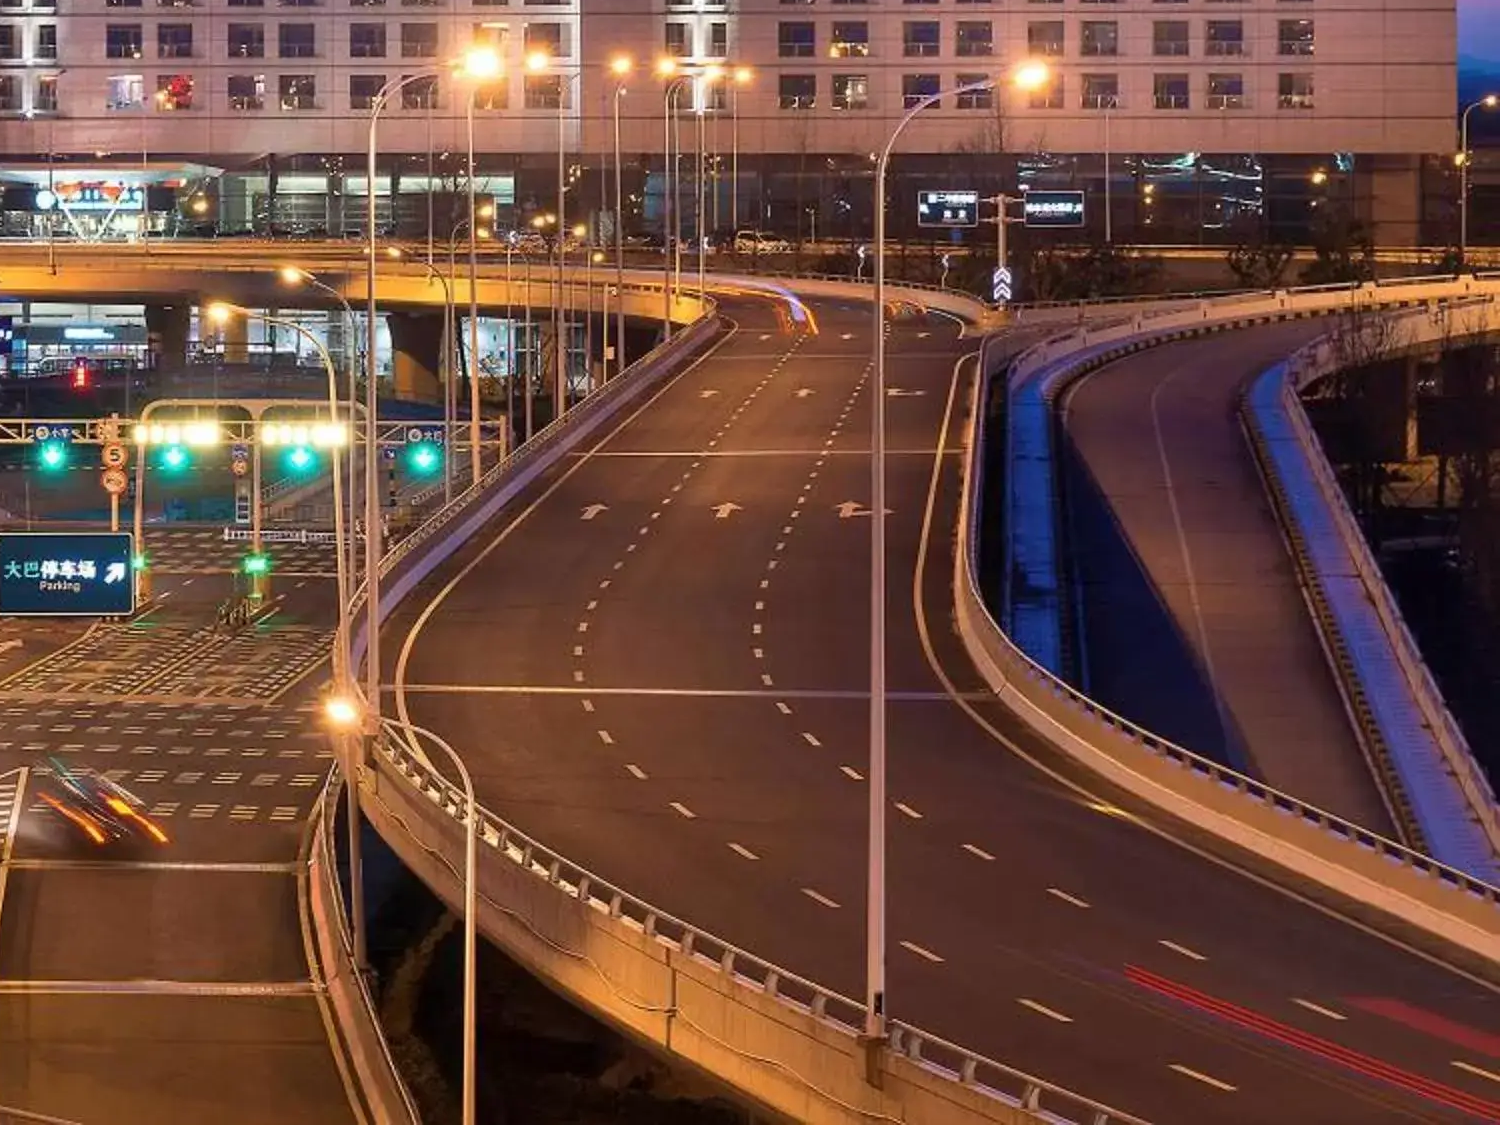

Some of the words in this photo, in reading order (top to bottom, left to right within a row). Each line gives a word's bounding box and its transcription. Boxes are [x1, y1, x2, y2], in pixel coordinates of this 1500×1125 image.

[4, 560, 97, 580] 大巴停车场
[40, 581, 80, 593] Parking
